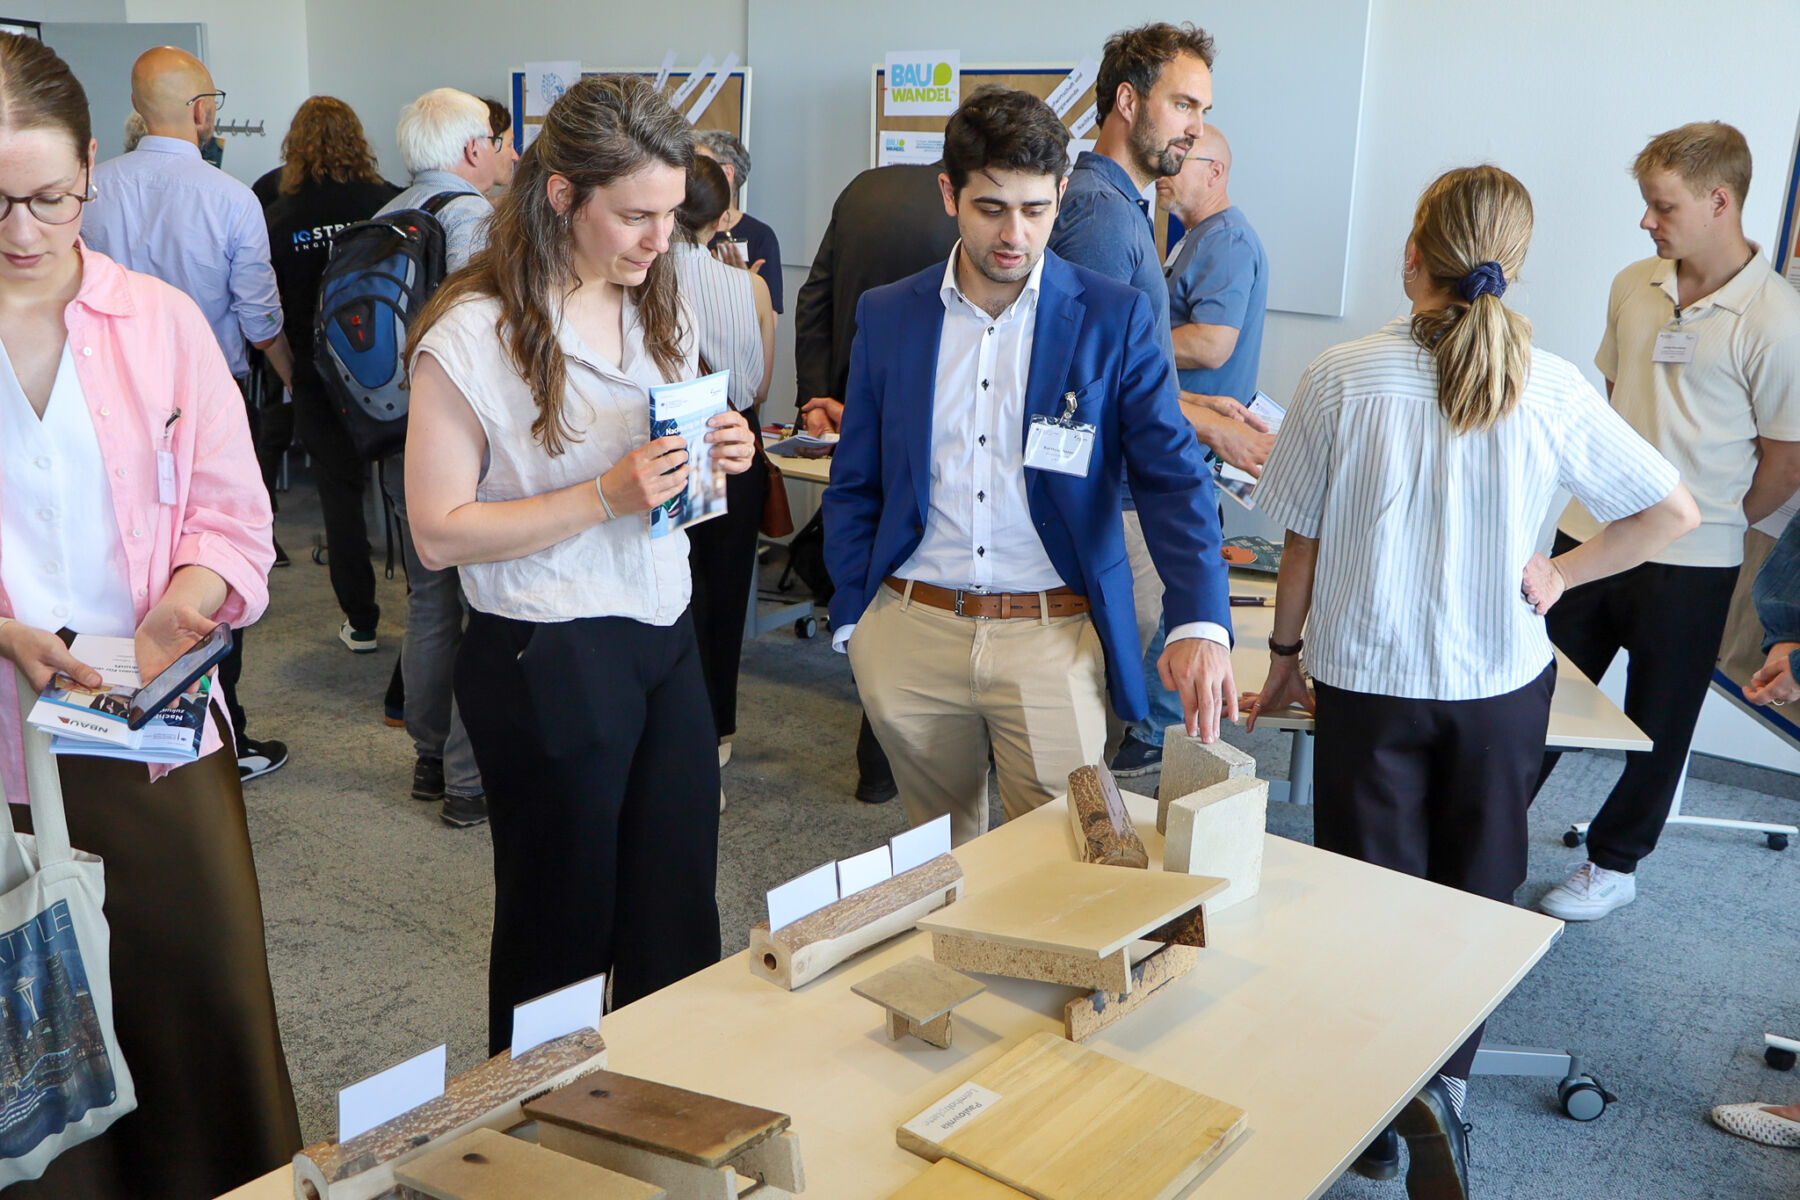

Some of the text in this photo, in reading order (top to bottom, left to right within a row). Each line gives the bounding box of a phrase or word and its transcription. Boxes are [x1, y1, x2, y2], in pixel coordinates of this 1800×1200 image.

[891, 63, 932, 87] BAU
[891, 87, 952, 103] WANDEL
[69, 720, 109, 734] NBAU
[0, 902, 72, 964] TTLE
